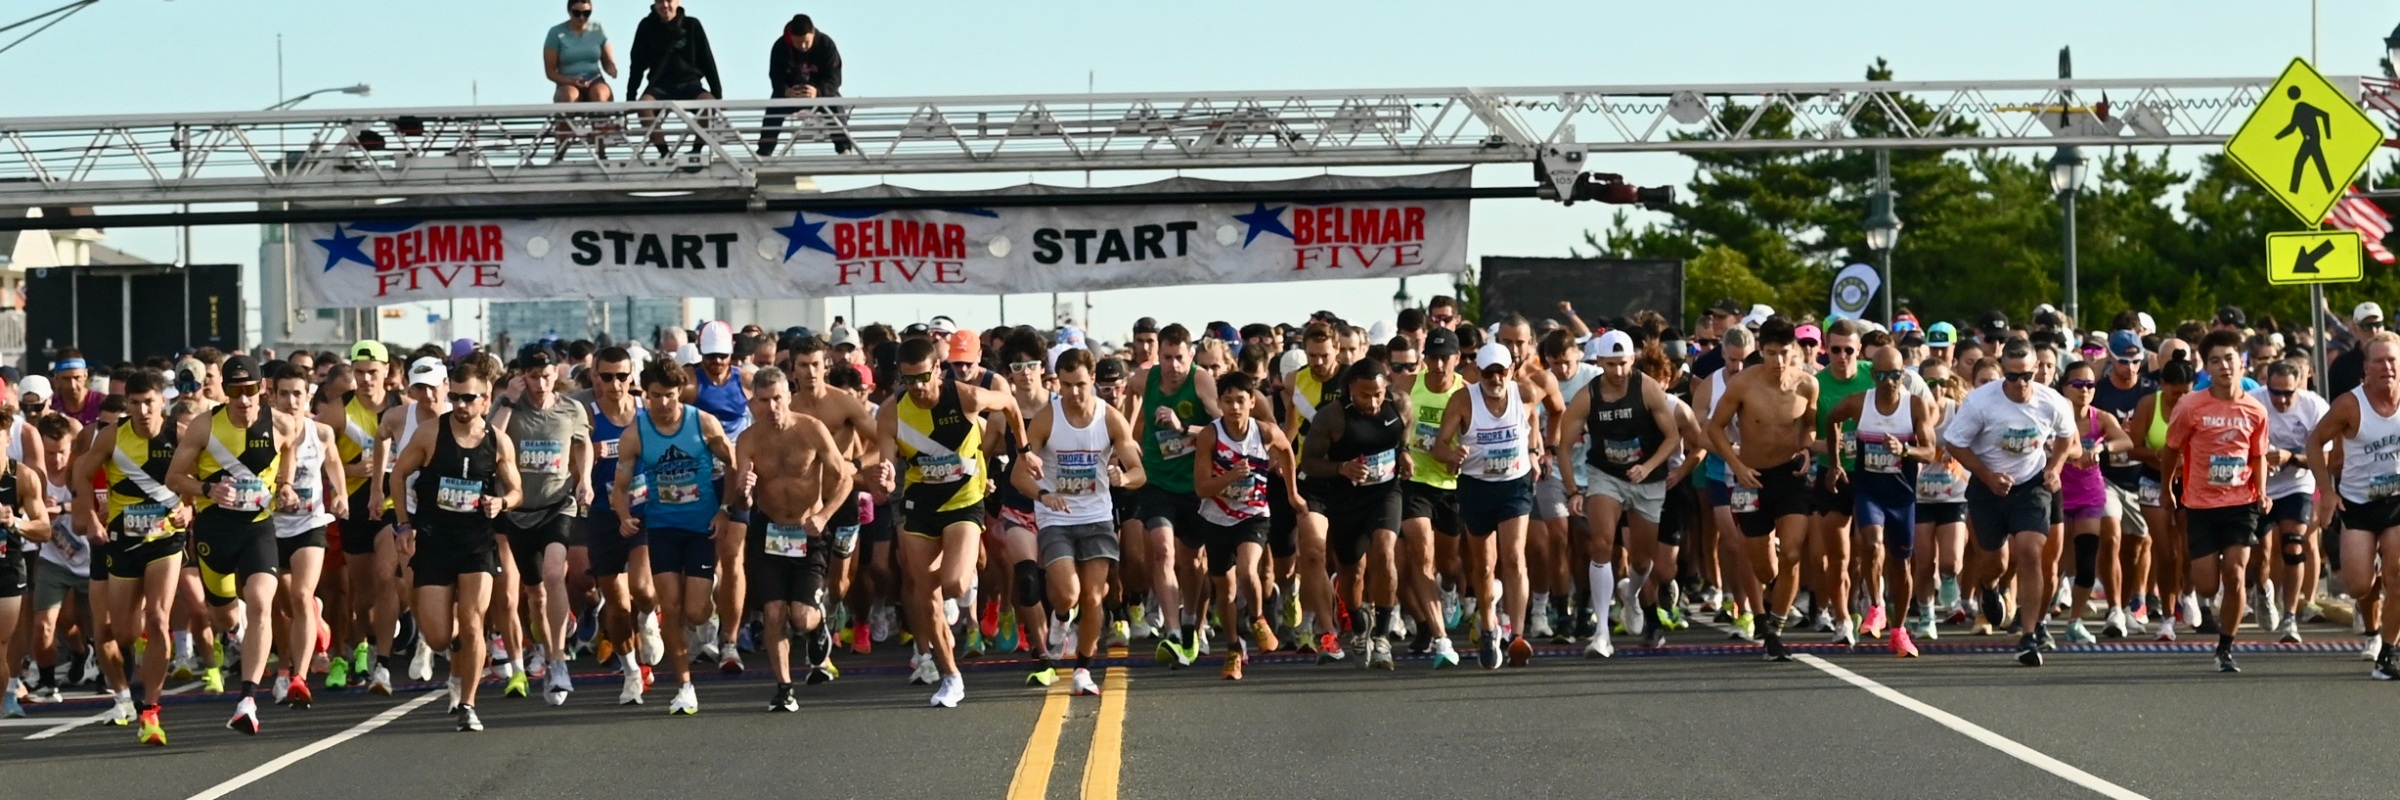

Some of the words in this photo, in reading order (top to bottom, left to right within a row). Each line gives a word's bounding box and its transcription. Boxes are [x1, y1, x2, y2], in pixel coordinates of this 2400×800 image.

[1294, 206, 1425, 245] BELMAR
[834, 219, 966, 260] BELMAR
[1032, 221, 1197, 264] START
[374, 224, 504, 272] BELMAR
[571, 229, 738, 269] START
[1292, 243, 1424, 270] FIVE
[374, 264, 505, 297] FIVE
[835, 260, 967, 286] FIVE
[939, 416, 960, 426] GSTC
[1599, 411, 1613, 421] THE
[1614, 408, 1632, 419] FORT
[1477, 431, 1503, 441] SHORE
[152, 449, 172, 458] GSTC
[523, 449, 552, 464] 3184
[1057, 454, 1084, 463] SHORE
[1059, 477, 1088, 490] 3126
[671, 485, 679, 499] 2
[127, 514, 157, 528] 3117
